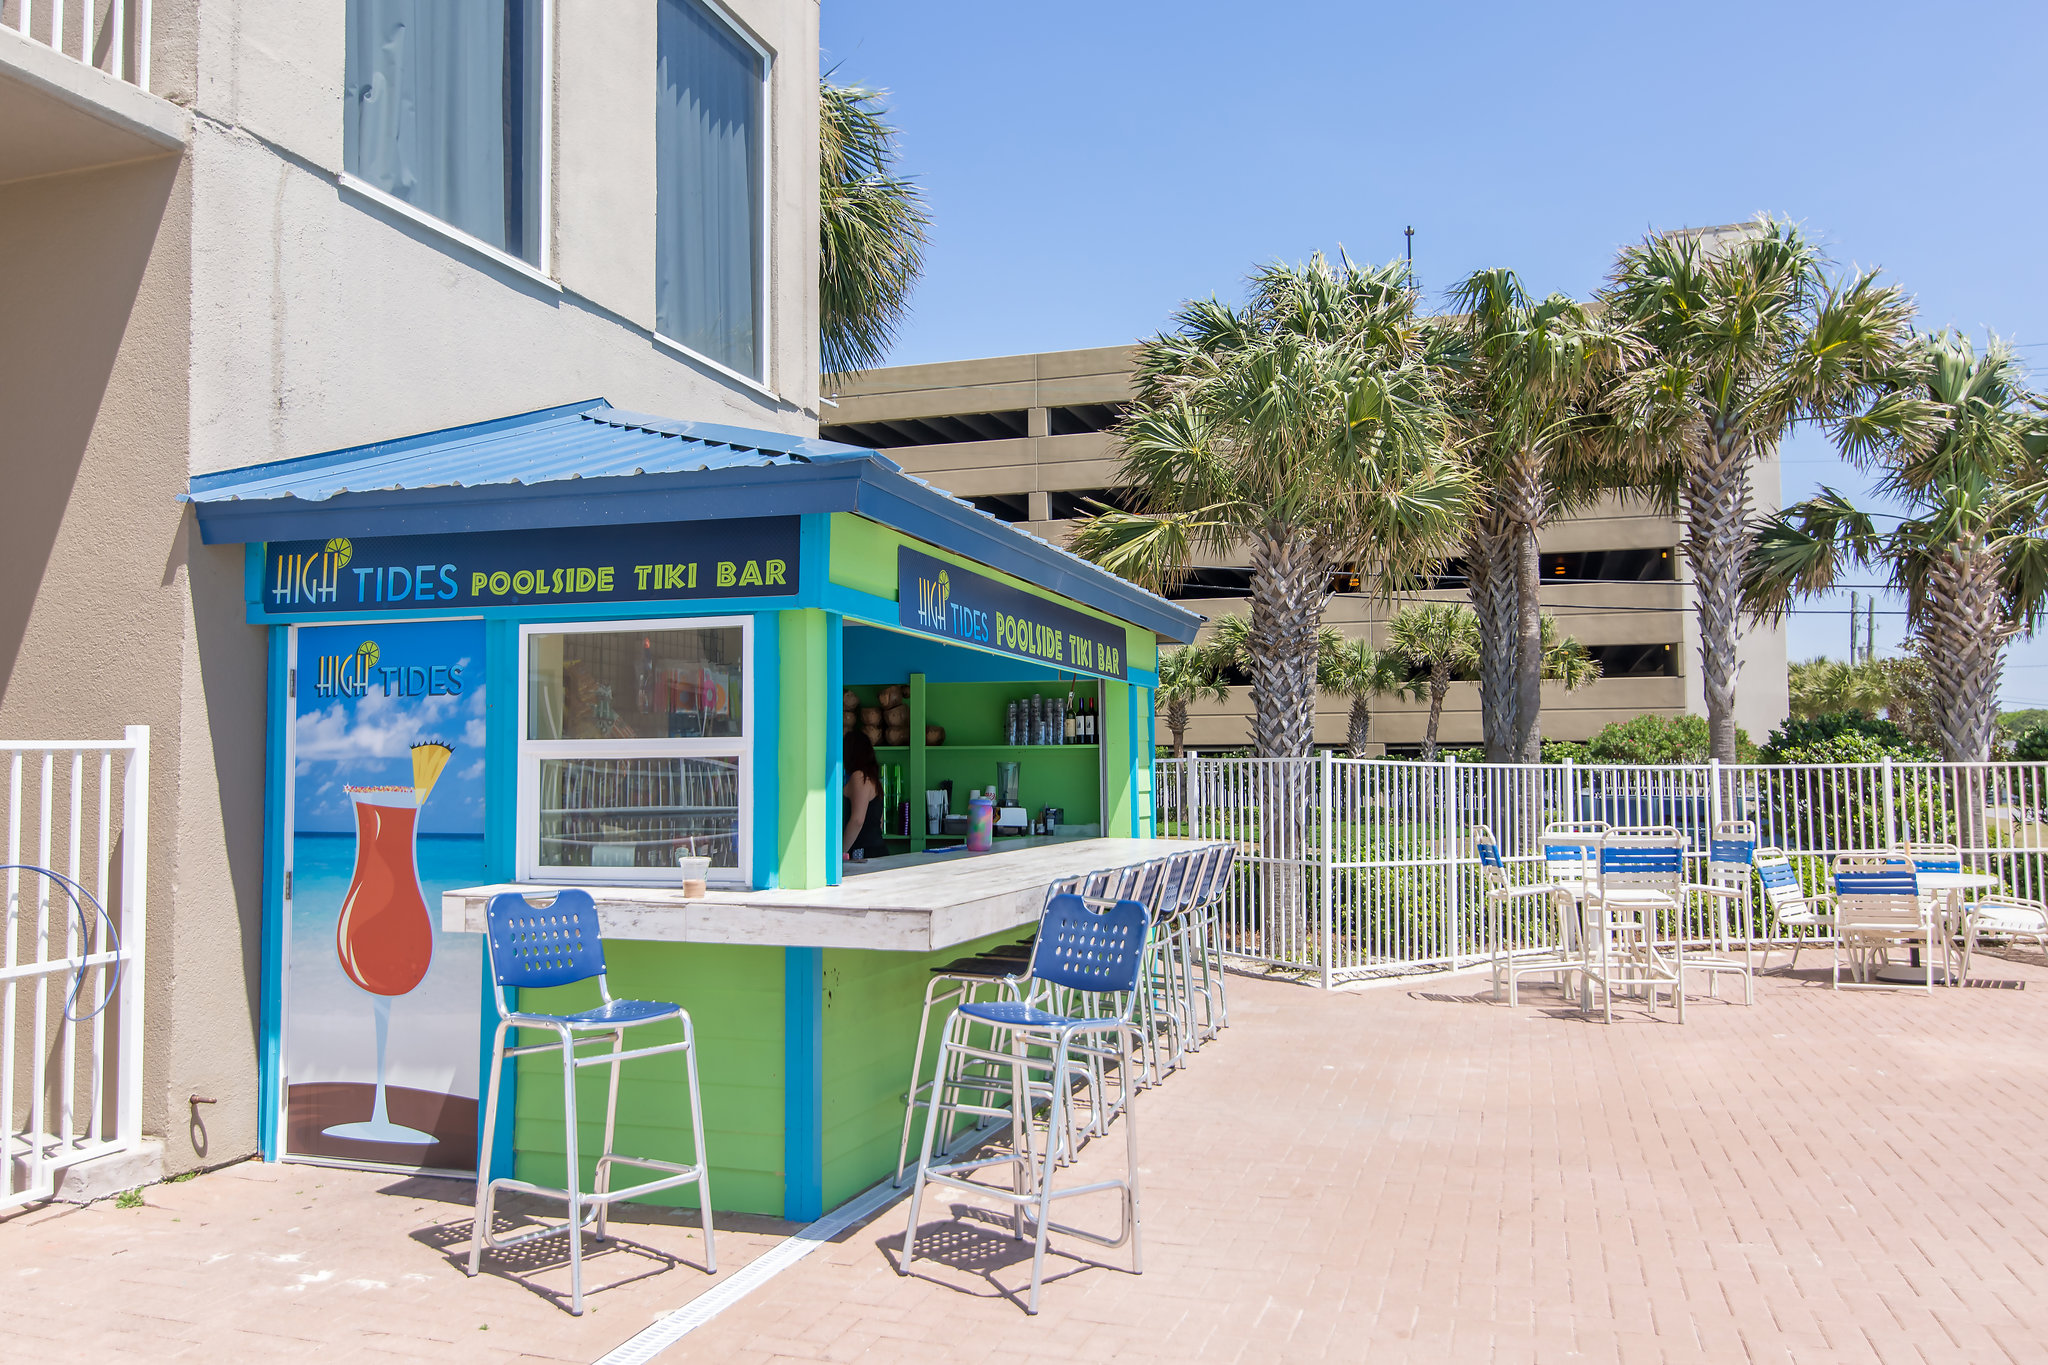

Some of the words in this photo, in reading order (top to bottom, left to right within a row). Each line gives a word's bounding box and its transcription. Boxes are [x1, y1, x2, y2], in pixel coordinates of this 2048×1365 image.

[272, 552, 339, 604] HIGH
[353, 564, 458, 603] TIDES
[471, 566, 615, 596] POOLSIDE
[634, 562, 697, 591] TIKI
[716, 559, 787, 587] BAR
[918, 577, 946, 630] HIGH
[950, 603, 989, 643] TIDES
[996, 611, 1063, 661] POOLSIDE
[1069, 634, 1093, 669] TIKI
[1098, 643, 1120, 675] BAR
[315, 651, 370, 697] HIGH
[380, 664, 465, 697] TIDES
